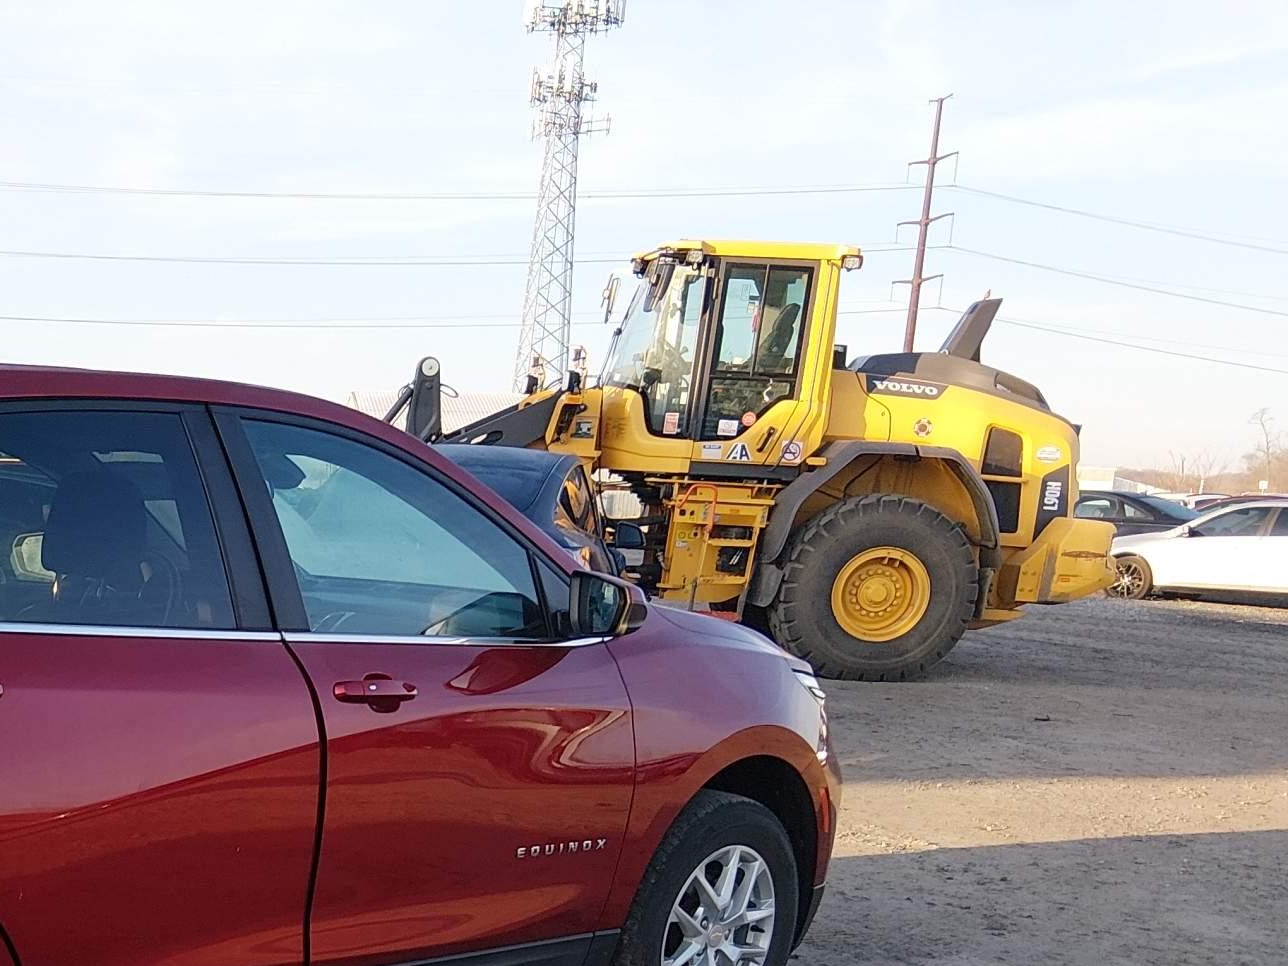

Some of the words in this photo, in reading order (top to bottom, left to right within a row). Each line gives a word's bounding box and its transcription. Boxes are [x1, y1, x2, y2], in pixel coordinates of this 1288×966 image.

[872, 380, 938, 396] VOLVO
[1043, 481, 1062, 511] L90H
[516, 838, 607, 859] EQUINOX
